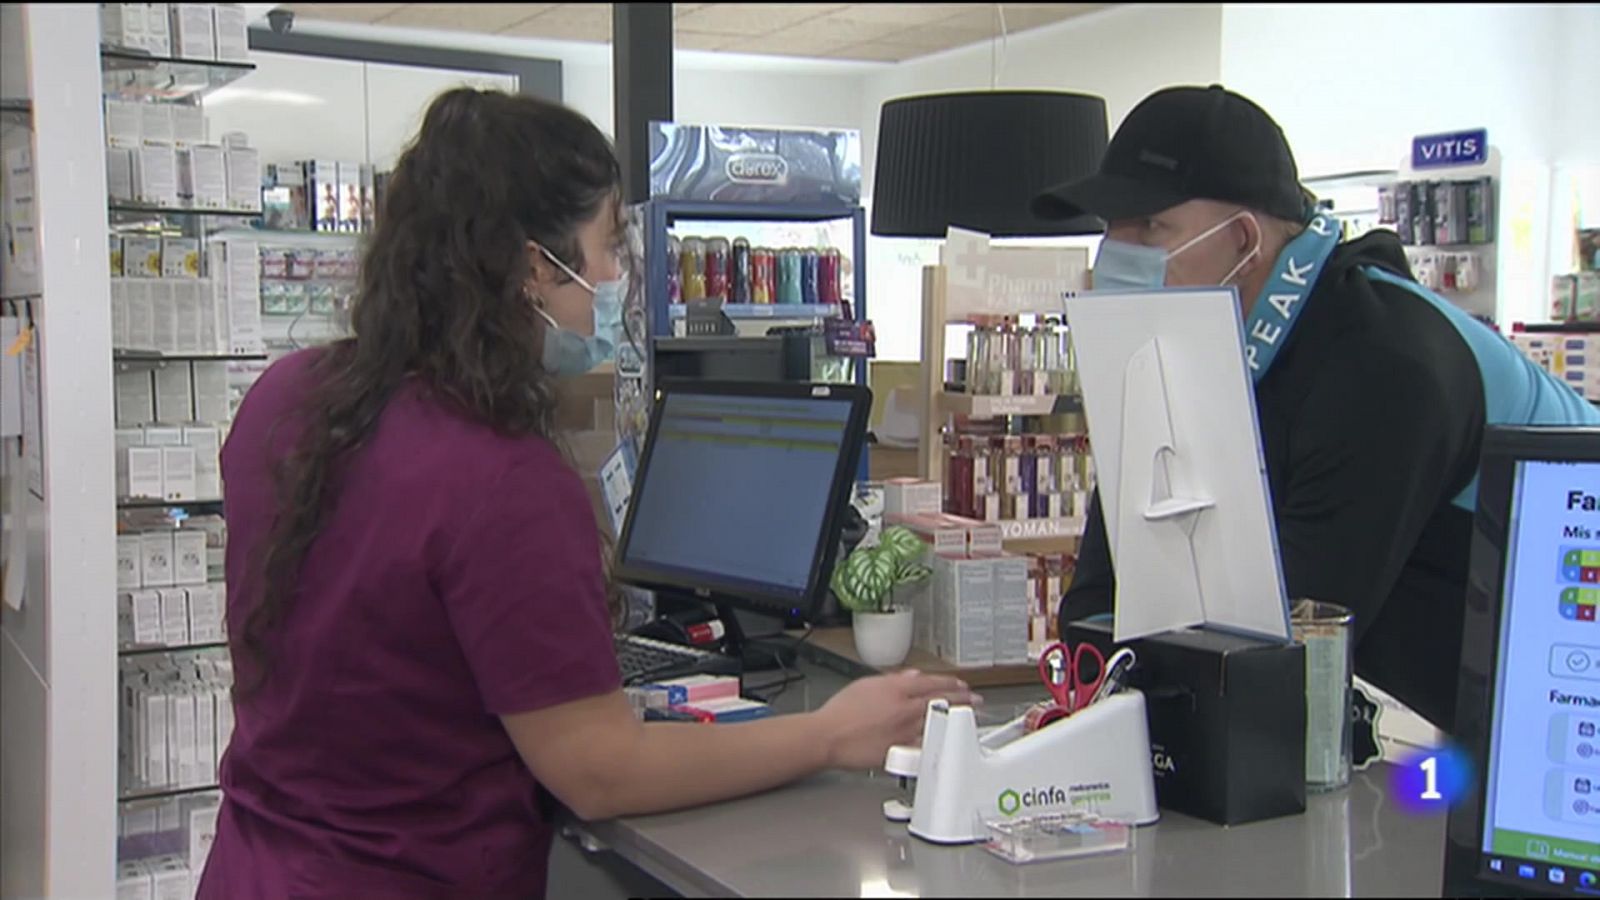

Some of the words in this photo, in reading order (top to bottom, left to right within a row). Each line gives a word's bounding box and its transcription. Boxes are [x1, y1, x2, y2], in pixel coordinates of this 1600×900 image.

[1420, 138, 1477, 159] VITIS
[1246, 257, 1314, 370] PEAK
[1563, 525, 1591, 539] Mis
[1549, 689, 1600, 708] Farma
[1022, 785, 1066, 807] cinfa
